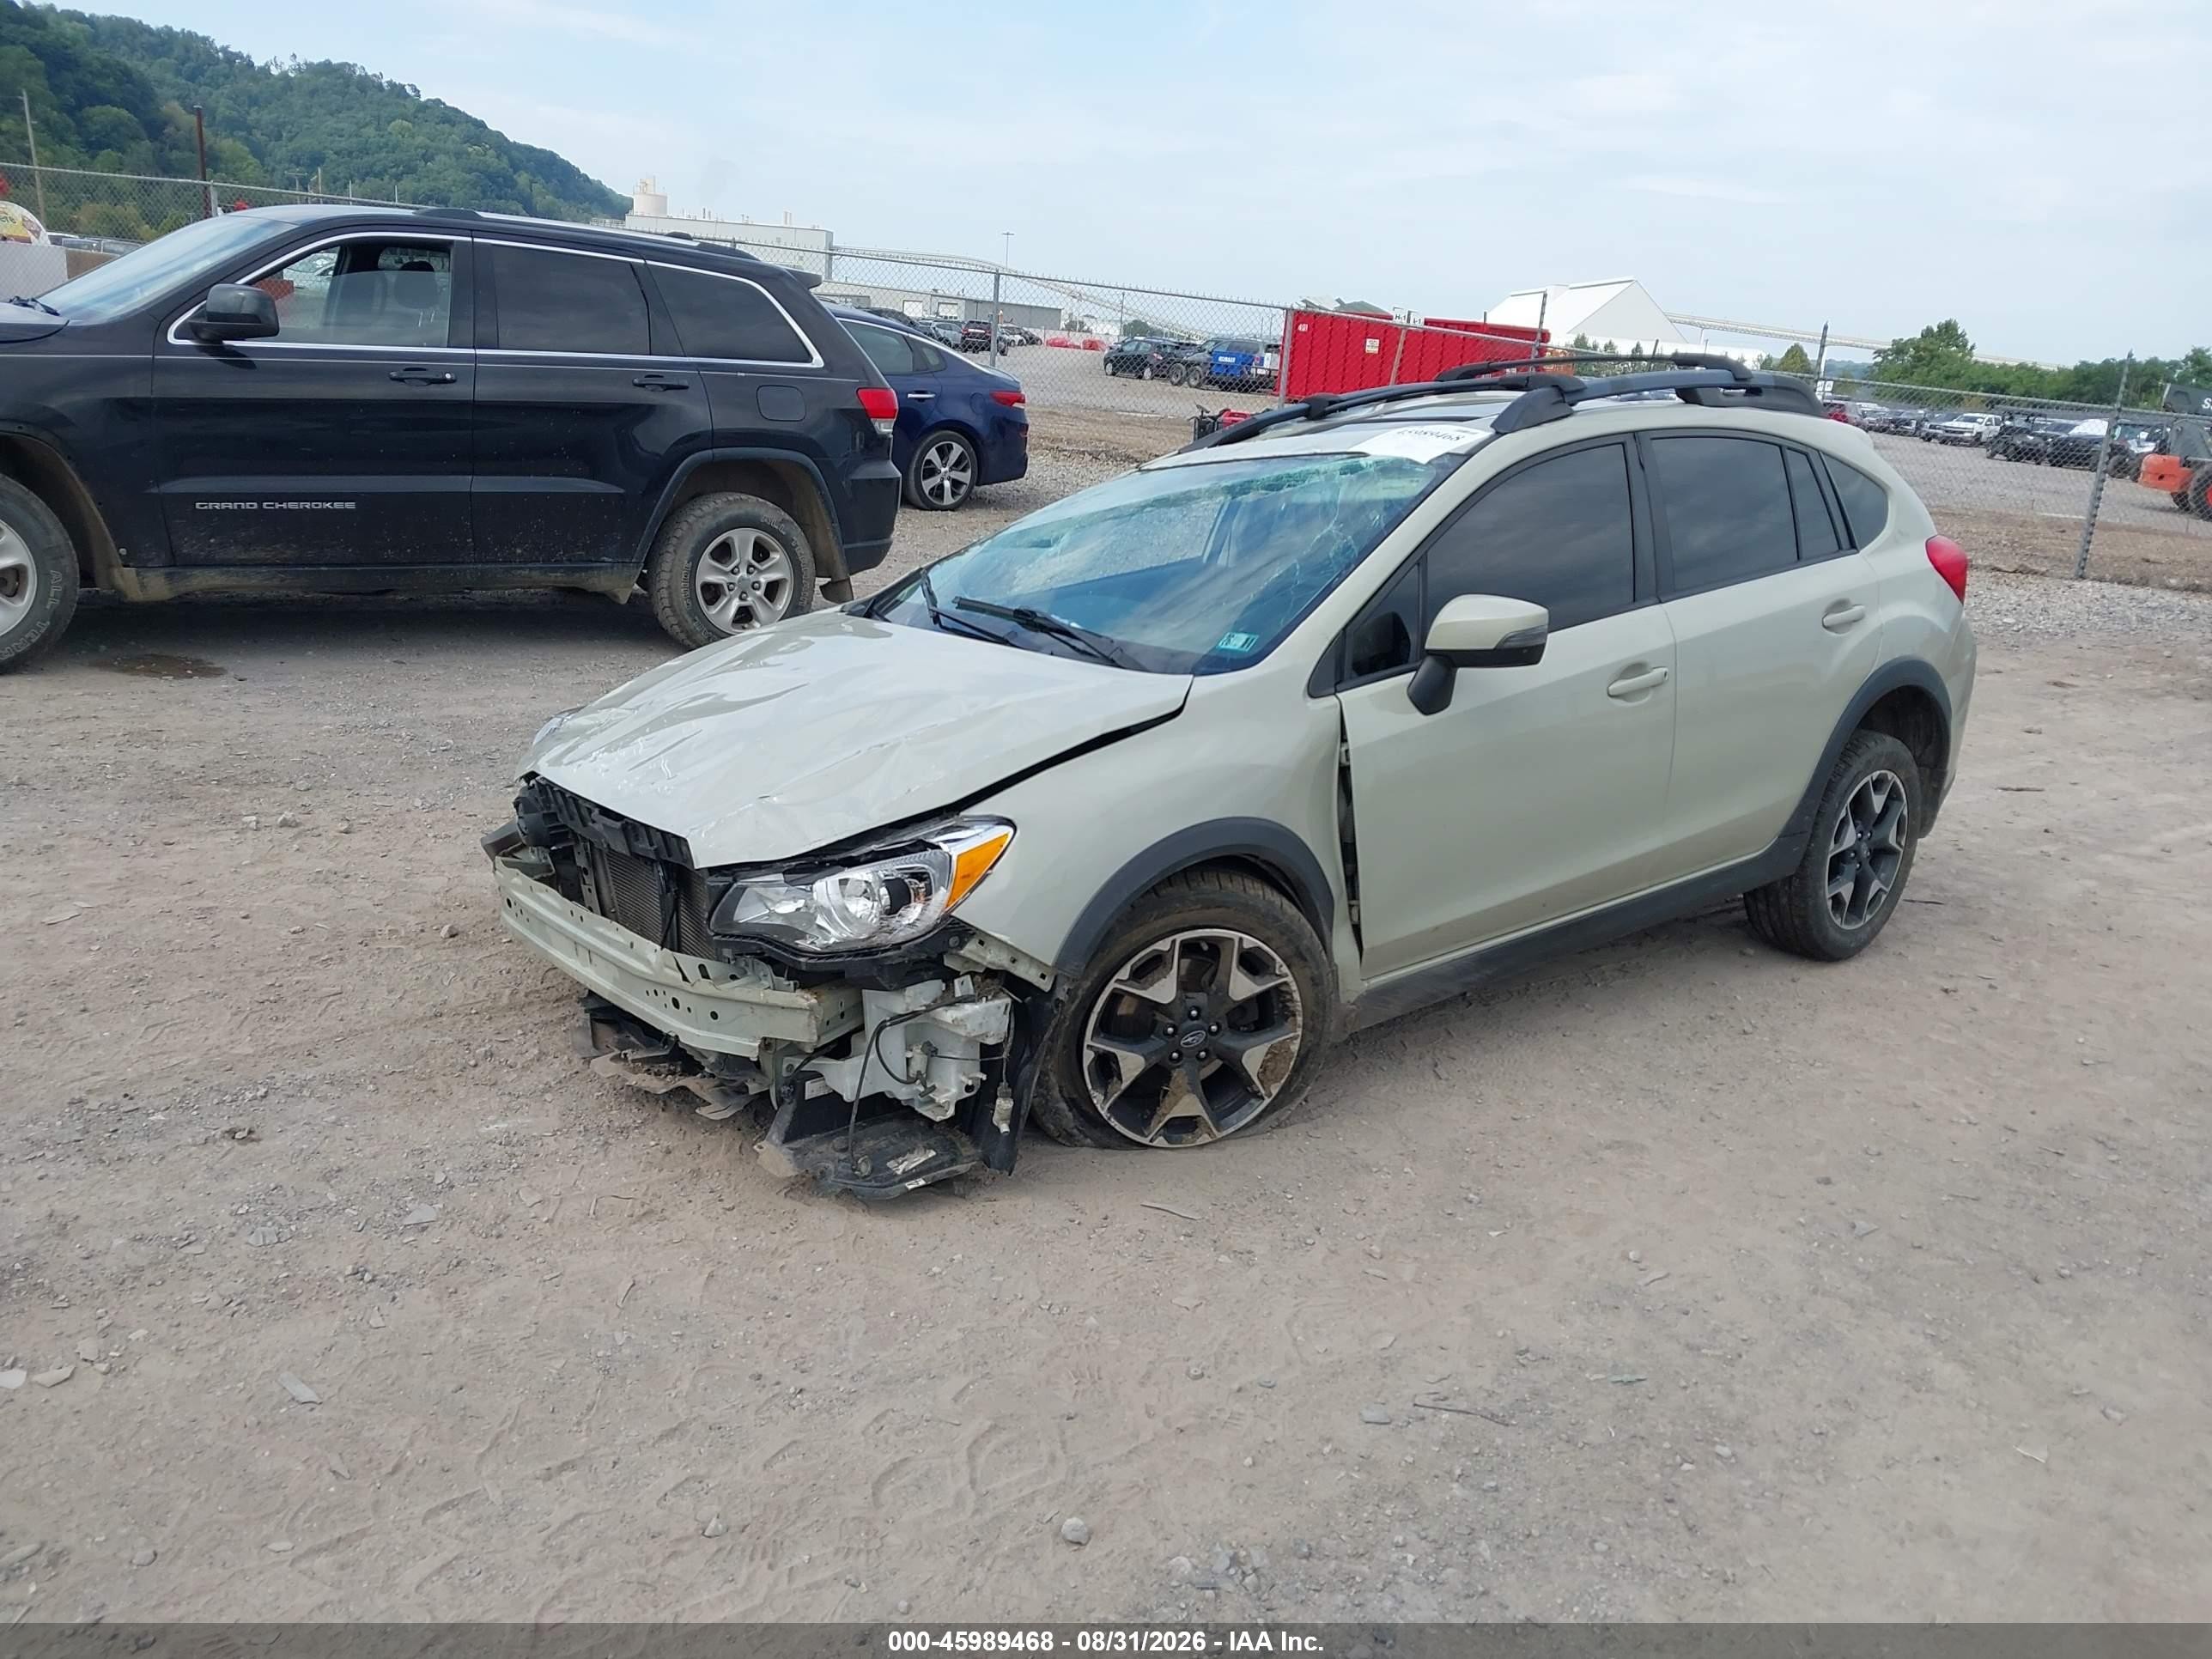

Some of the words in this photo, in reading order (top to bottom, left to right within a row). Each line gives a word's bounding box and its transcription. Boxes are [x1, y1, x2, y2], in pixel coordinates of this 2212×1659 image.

[2201, 398, 2212, 409] S
[195, 501, 258, 510] GRAND
[49, 569, 63, 610] ALL
